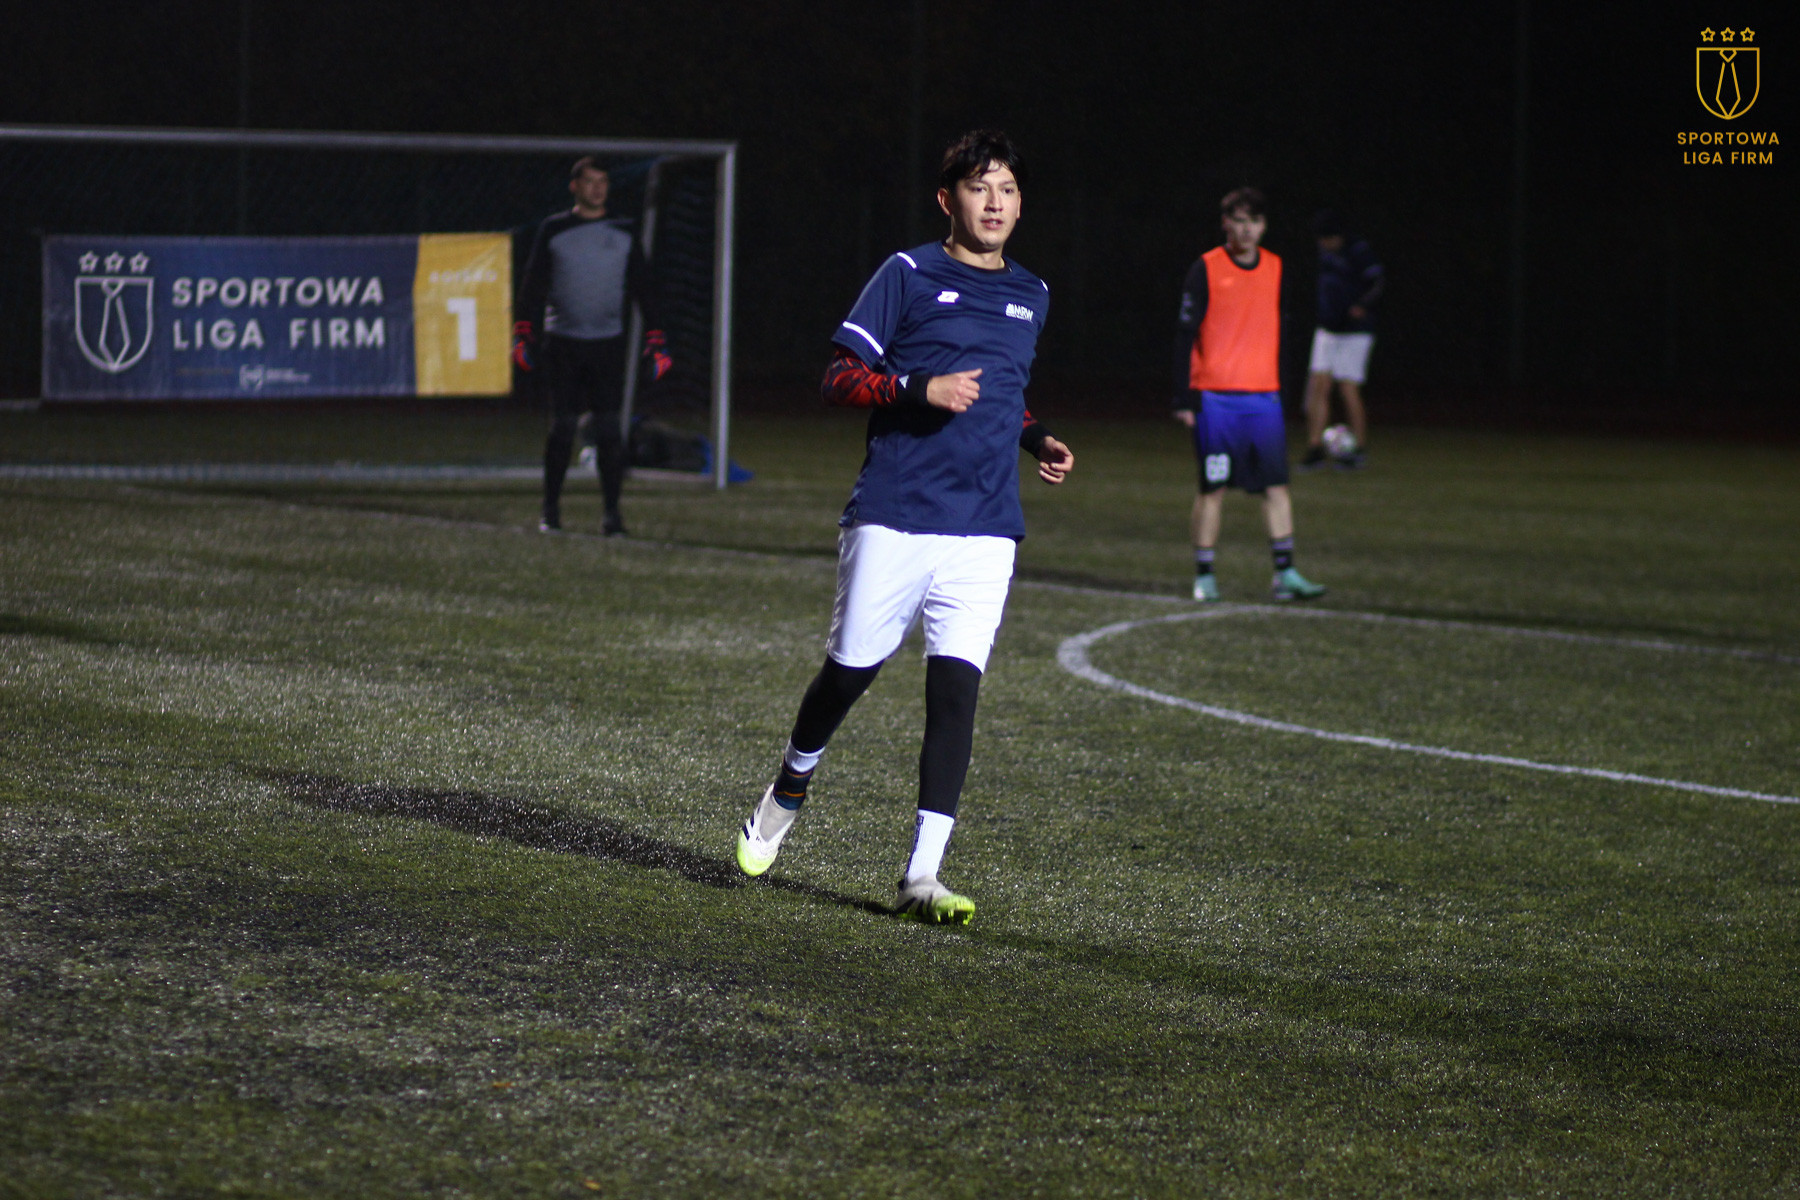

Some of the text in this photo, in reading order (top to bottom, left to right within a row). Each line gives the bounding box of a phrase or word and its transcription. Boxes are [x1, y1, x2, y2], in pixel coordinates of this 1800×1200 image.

[172, 276, 384, 307] SPORTOWA
[173, 316, 385, 350] LIGA FIRM
[447, 298, 477, 361] 1
